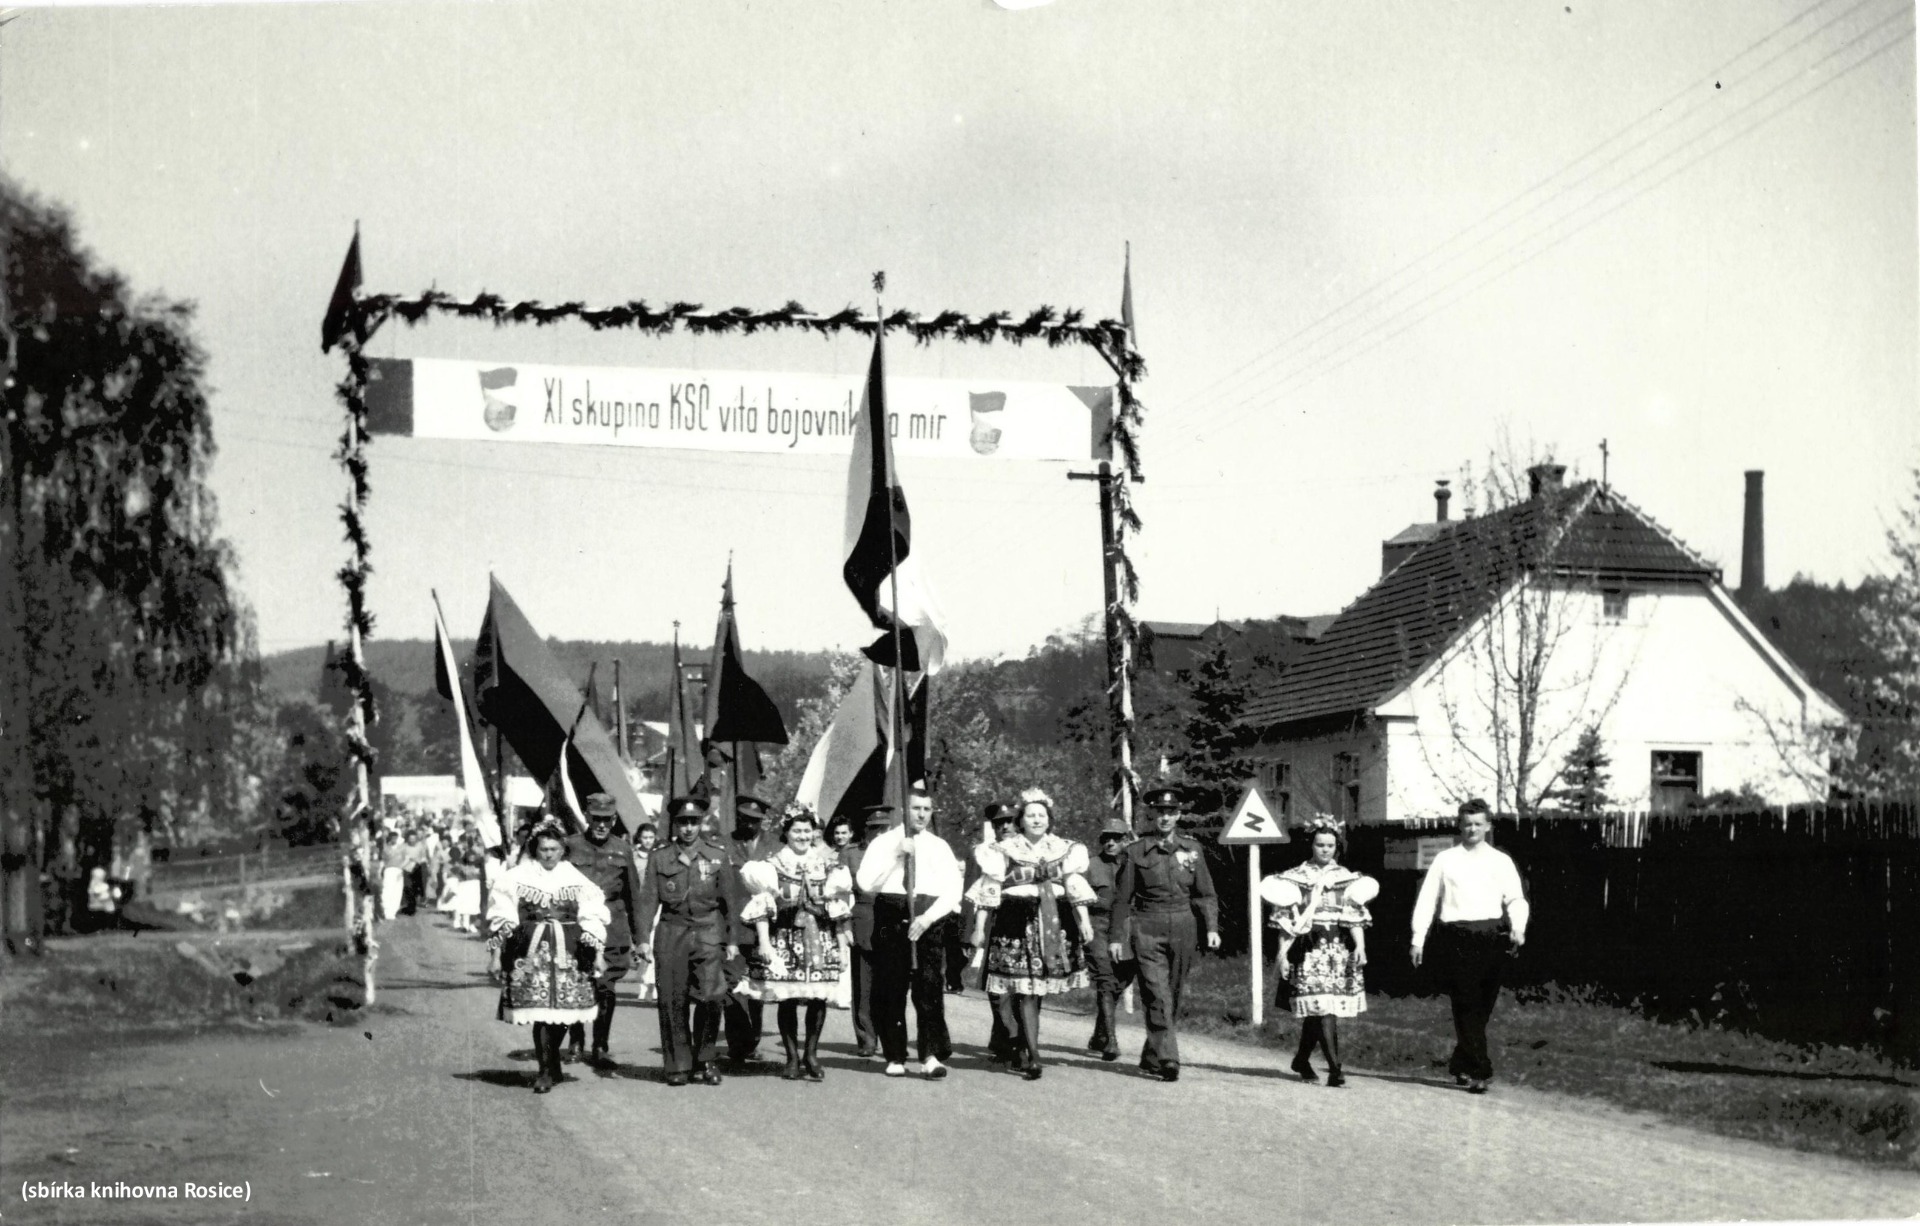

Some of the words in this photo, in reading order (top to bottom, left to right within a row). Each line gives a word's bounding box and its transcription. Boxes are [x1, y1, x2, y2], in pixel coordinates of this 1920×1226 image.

[544, 377, 563, 424] XI
[571, 379, 661, 437] skupina
[669, 377, 710, 431] KSČ
[718, 385, 758, 433] vítá
[767, 387, 866, 448] bojovník
[910, 404, 948, 440] mír
